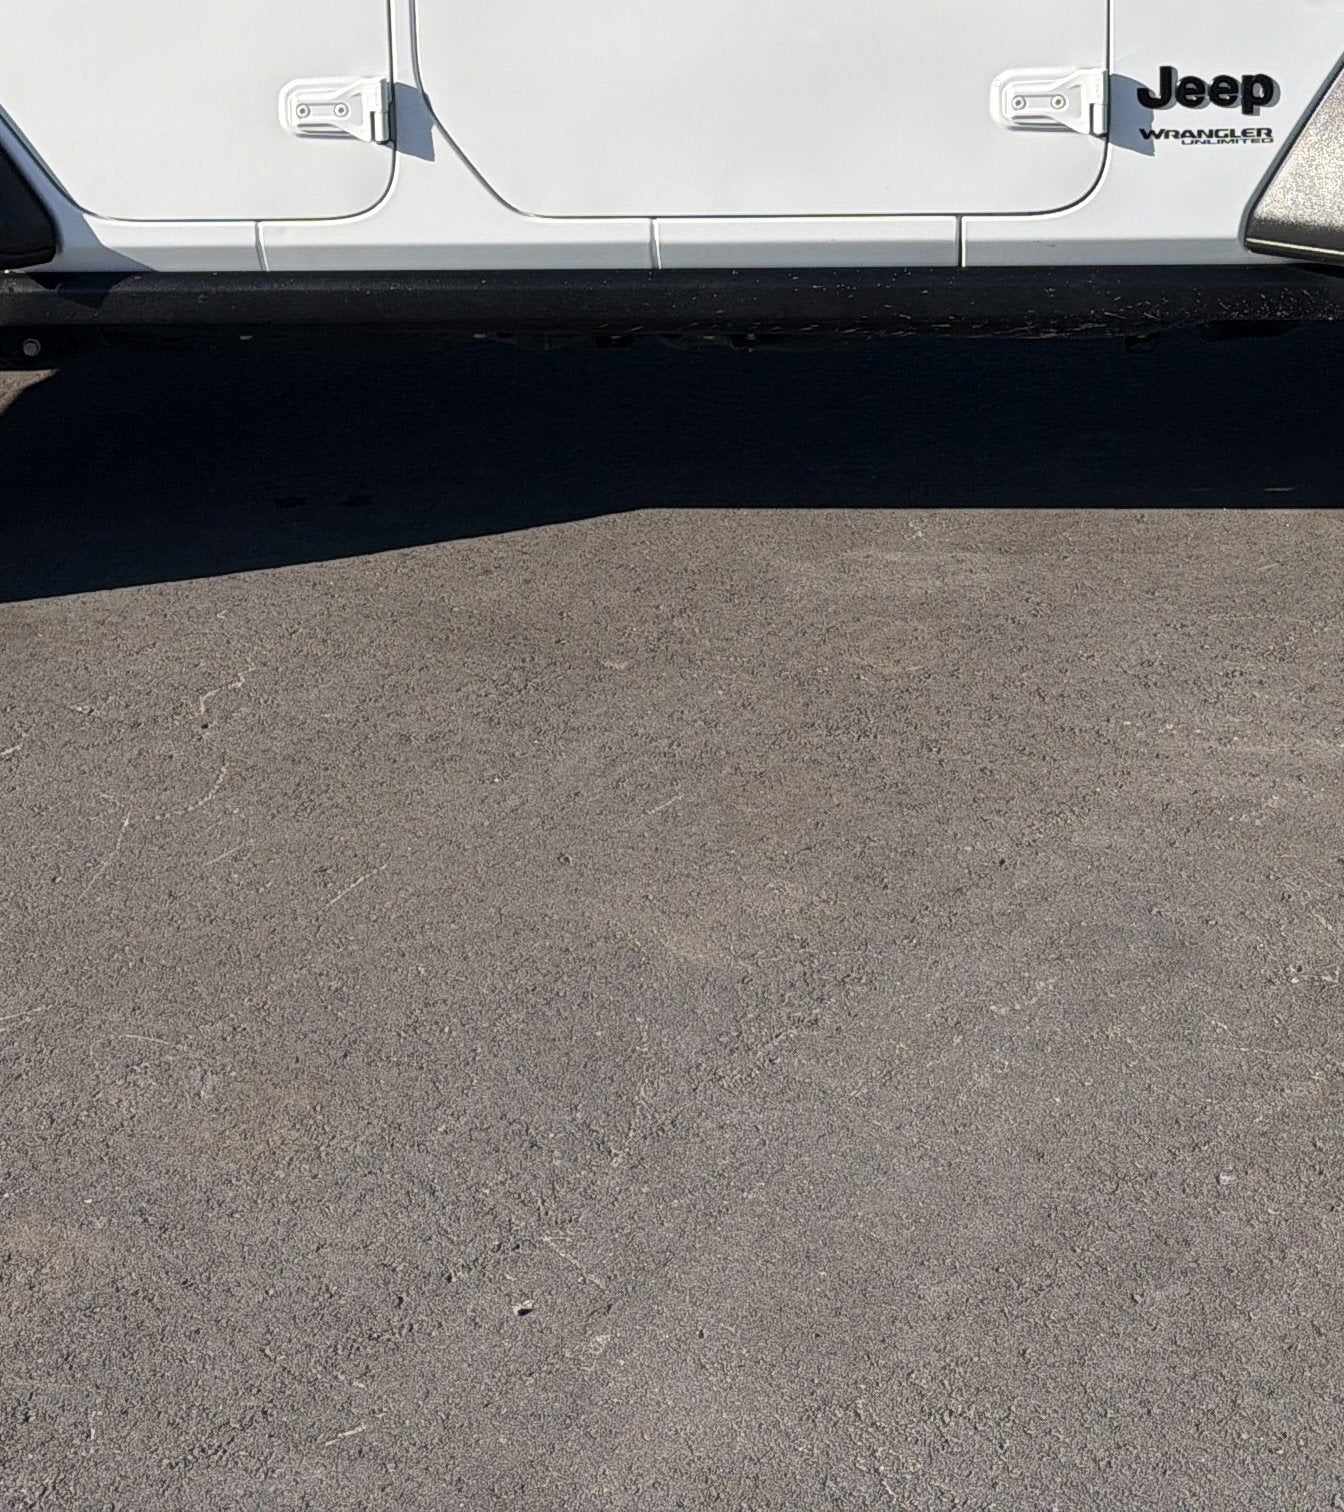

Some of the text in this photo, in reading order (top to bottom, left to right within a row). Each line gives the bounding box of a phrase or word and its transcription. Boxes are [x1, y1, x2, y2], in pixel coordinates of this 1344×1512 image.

[1137, 65, 1275, 115] Jeep
[1139, 127, 1273, 140] WRANGLER
[1181, 137, 1274, 146] UNLIMITED
